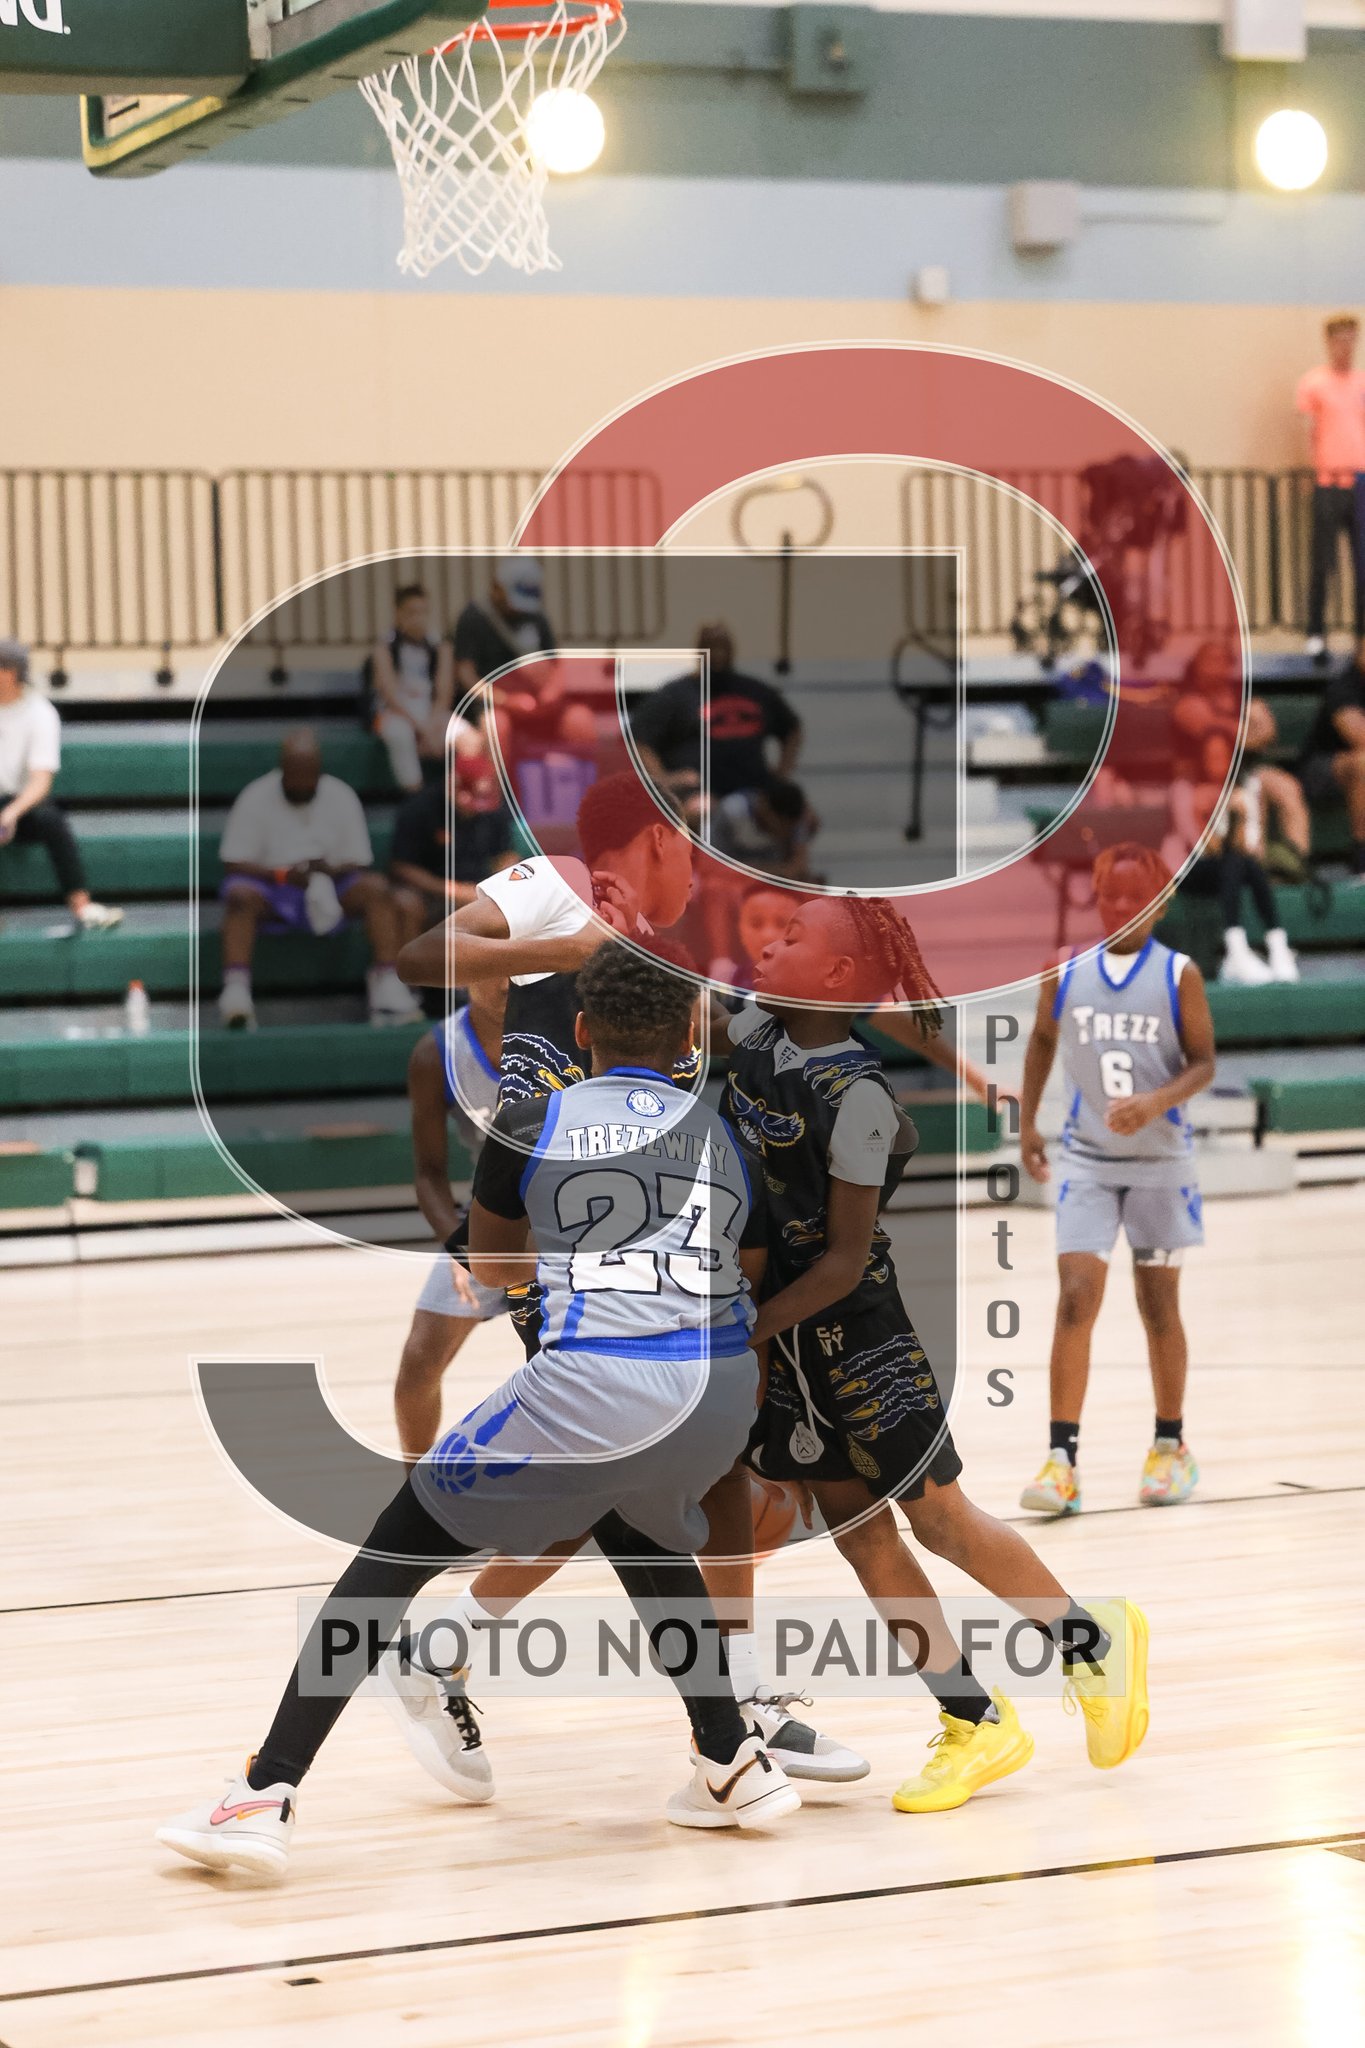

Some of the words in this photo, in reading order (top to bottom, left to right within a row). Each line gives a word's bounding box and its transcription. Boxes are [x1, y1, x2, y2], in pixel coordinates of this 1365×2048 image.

[1100, 1049, 1134, 1100] 6
[565, 1122, 728, 1177] TREZZWAY
[553, 1167, 744, 1299] 23
